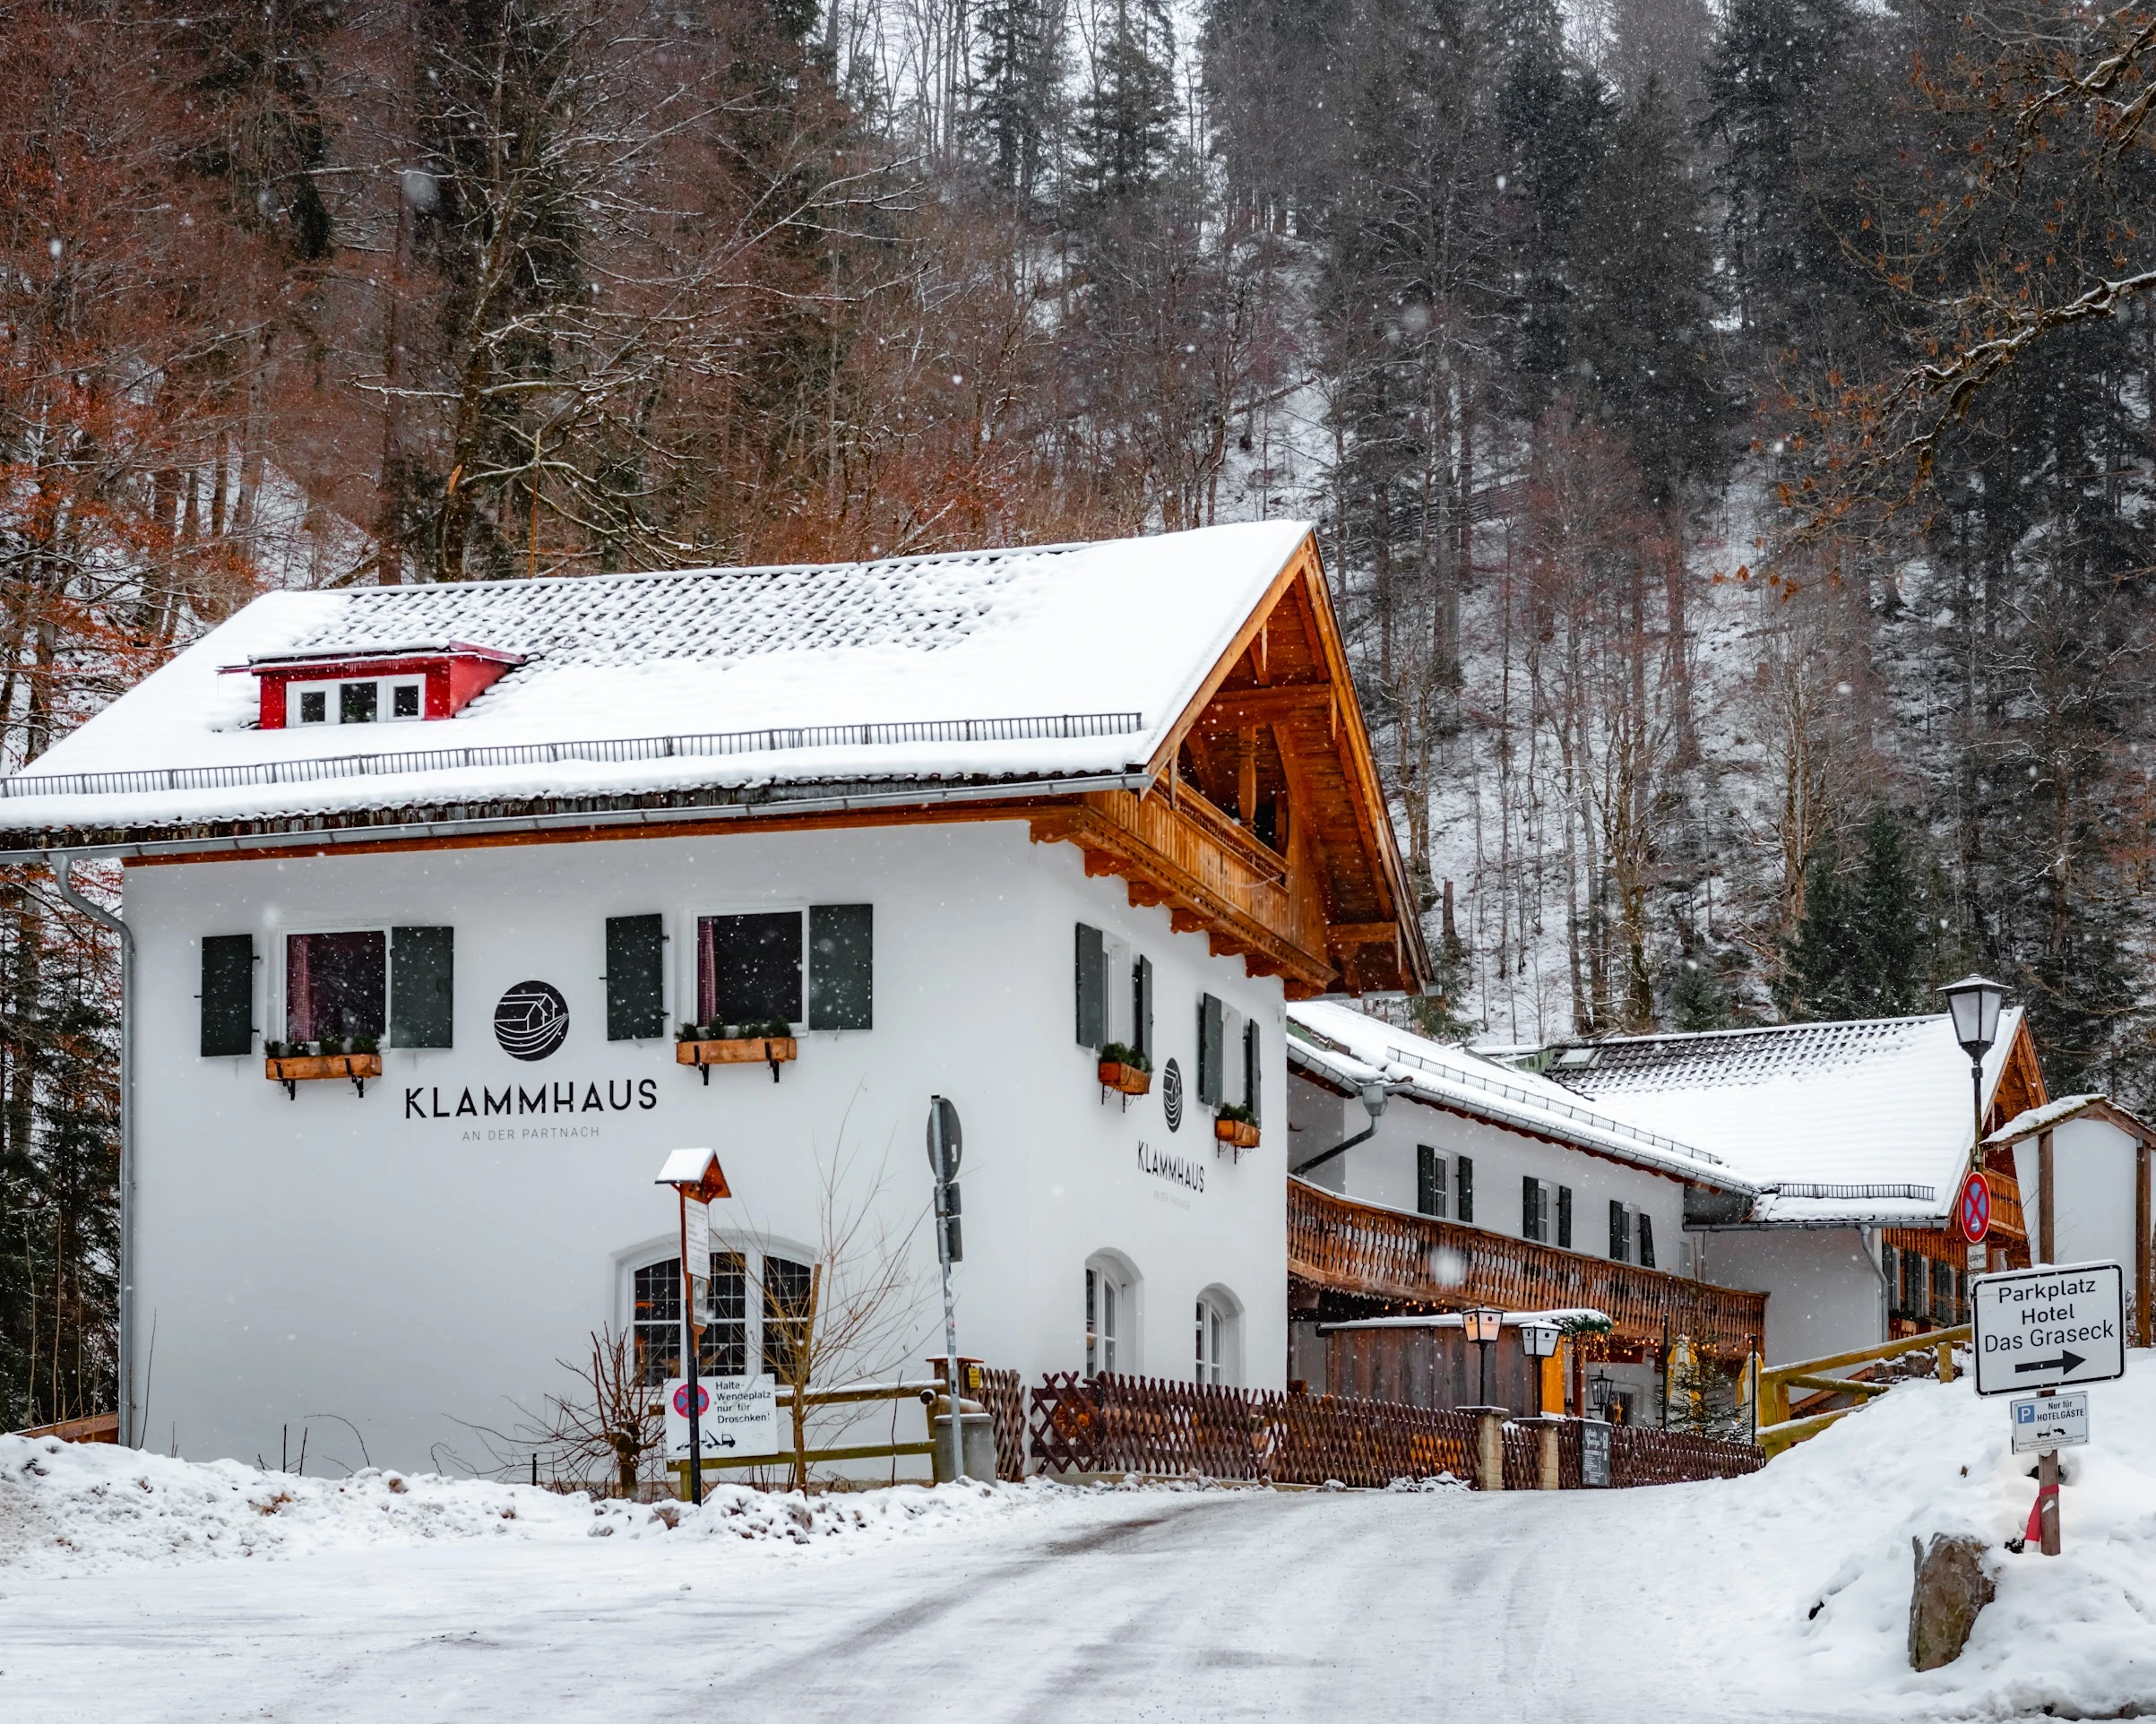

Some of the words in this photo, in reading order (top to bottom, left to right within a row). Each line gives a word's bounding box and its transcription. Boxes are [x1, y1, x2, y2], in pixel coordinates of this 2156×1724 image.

[406, 1079, 657, 1119] KLAMMHAUS
[462, 1131, 481, 1142] AN
[488, 1128, 515, 1141] DER
[522, 1126, 599, 1139] PARTNACH
[1137, 1140, 1204, 1194] KLAMMHAUS
[1998, 1279, 2096, 1303] Parkplatz
[2022, 1303, 2074, 1324] Hotel
[1985, 1334, 2022, 1352] Das
[2030, 1319, 2114, 1347] Graseck
[715, 1381, 744, 1391] Halte-
[717, 1391, 771, 1401] Wendeplatz
[717, 1404, 732, 1412] nur
[737, 1403, 751, 1411] für
[2048, 1401, 2060, 1409] Nur
[2063, 1400, 2073, 1409] für
[717, 1412, 771, 1424] Droschken!
[2037, 1408, 2084, 1422] HOTELGÄSTE
